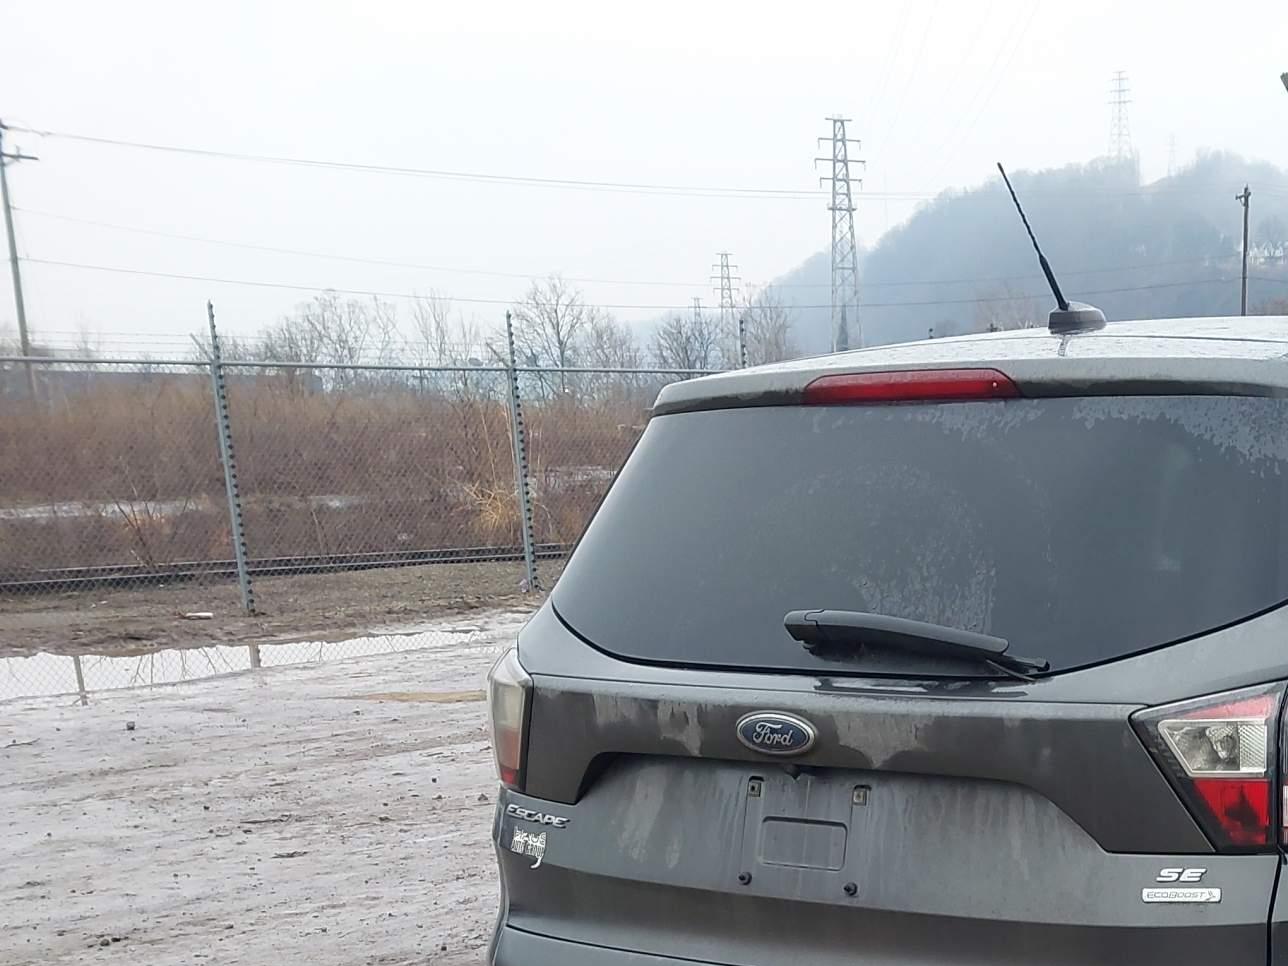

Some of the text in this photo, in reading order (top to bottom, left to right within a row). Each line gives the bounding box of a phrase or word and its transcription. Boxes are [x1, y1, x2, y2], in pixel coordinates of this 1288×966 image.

[753, 722, 793, 746] Ford
[506, 803, 569, 828] ESCAPE
[1156, 867, 1207, 882] SE
